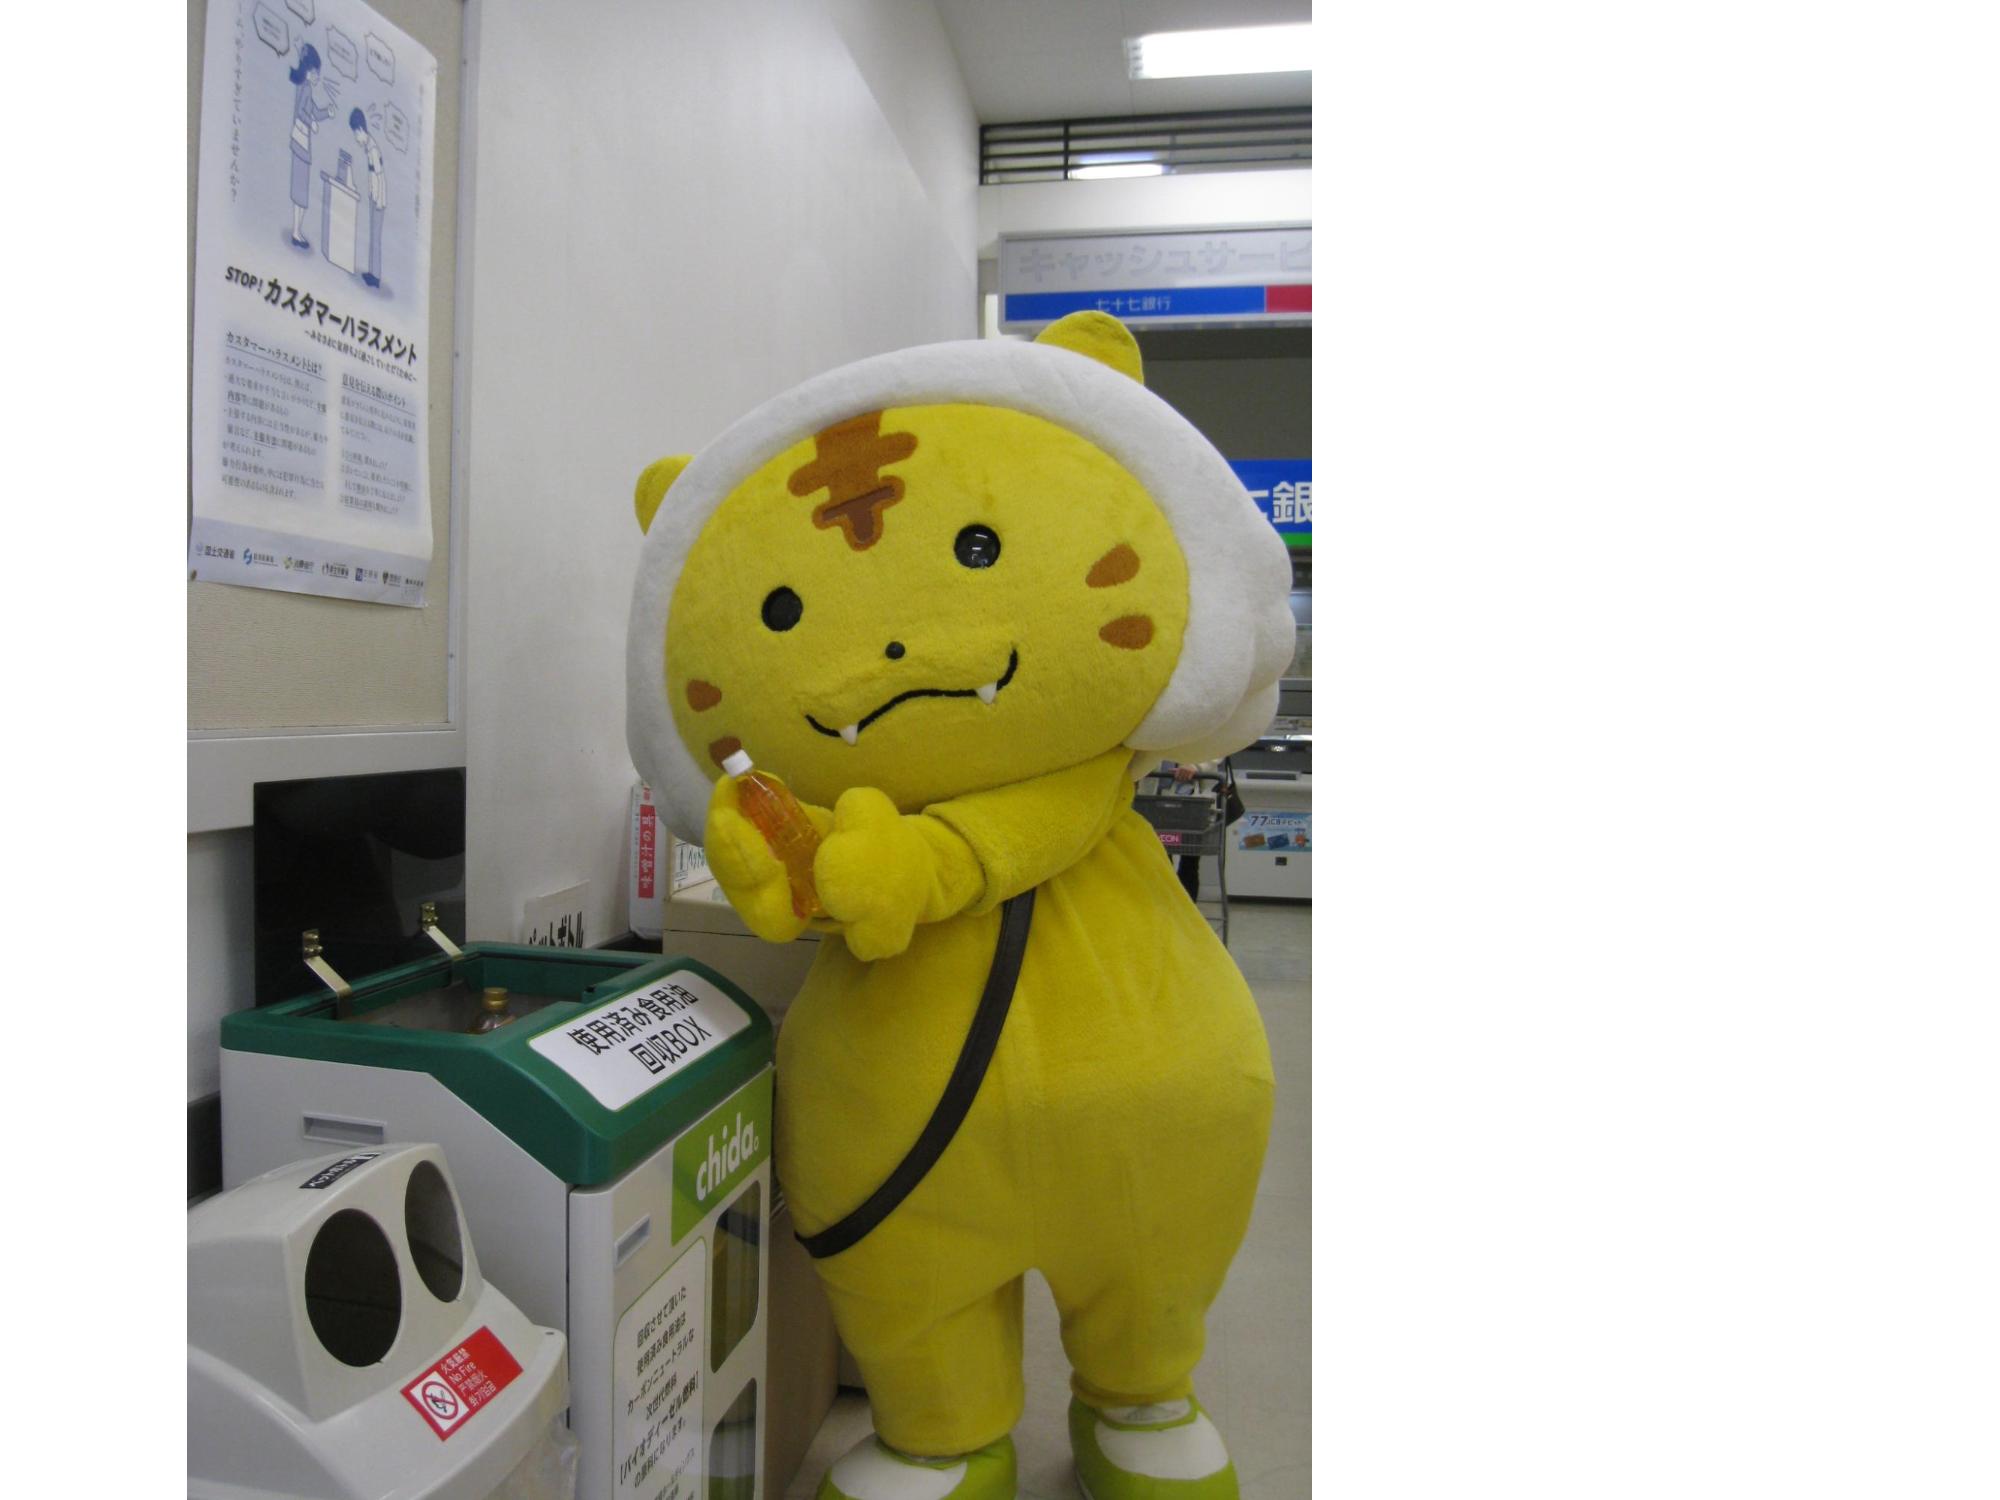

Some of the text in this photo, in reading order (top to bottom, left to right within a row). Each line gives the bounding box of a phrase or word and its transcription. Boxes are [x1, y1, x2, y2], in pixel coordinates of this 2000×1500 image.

[225, 265, 417, 366] STOP! カスタマーハラスメント
[1095, 296, 1172, 313] 七十七銀行
[640, 813, 656, 889] 味噌汁の具
[567, 983, 699, 1055] 使用済み食用油
[628, 1016, 712, 1075] 回収BOX
[448, 1361, 477, 1385] No Fire
